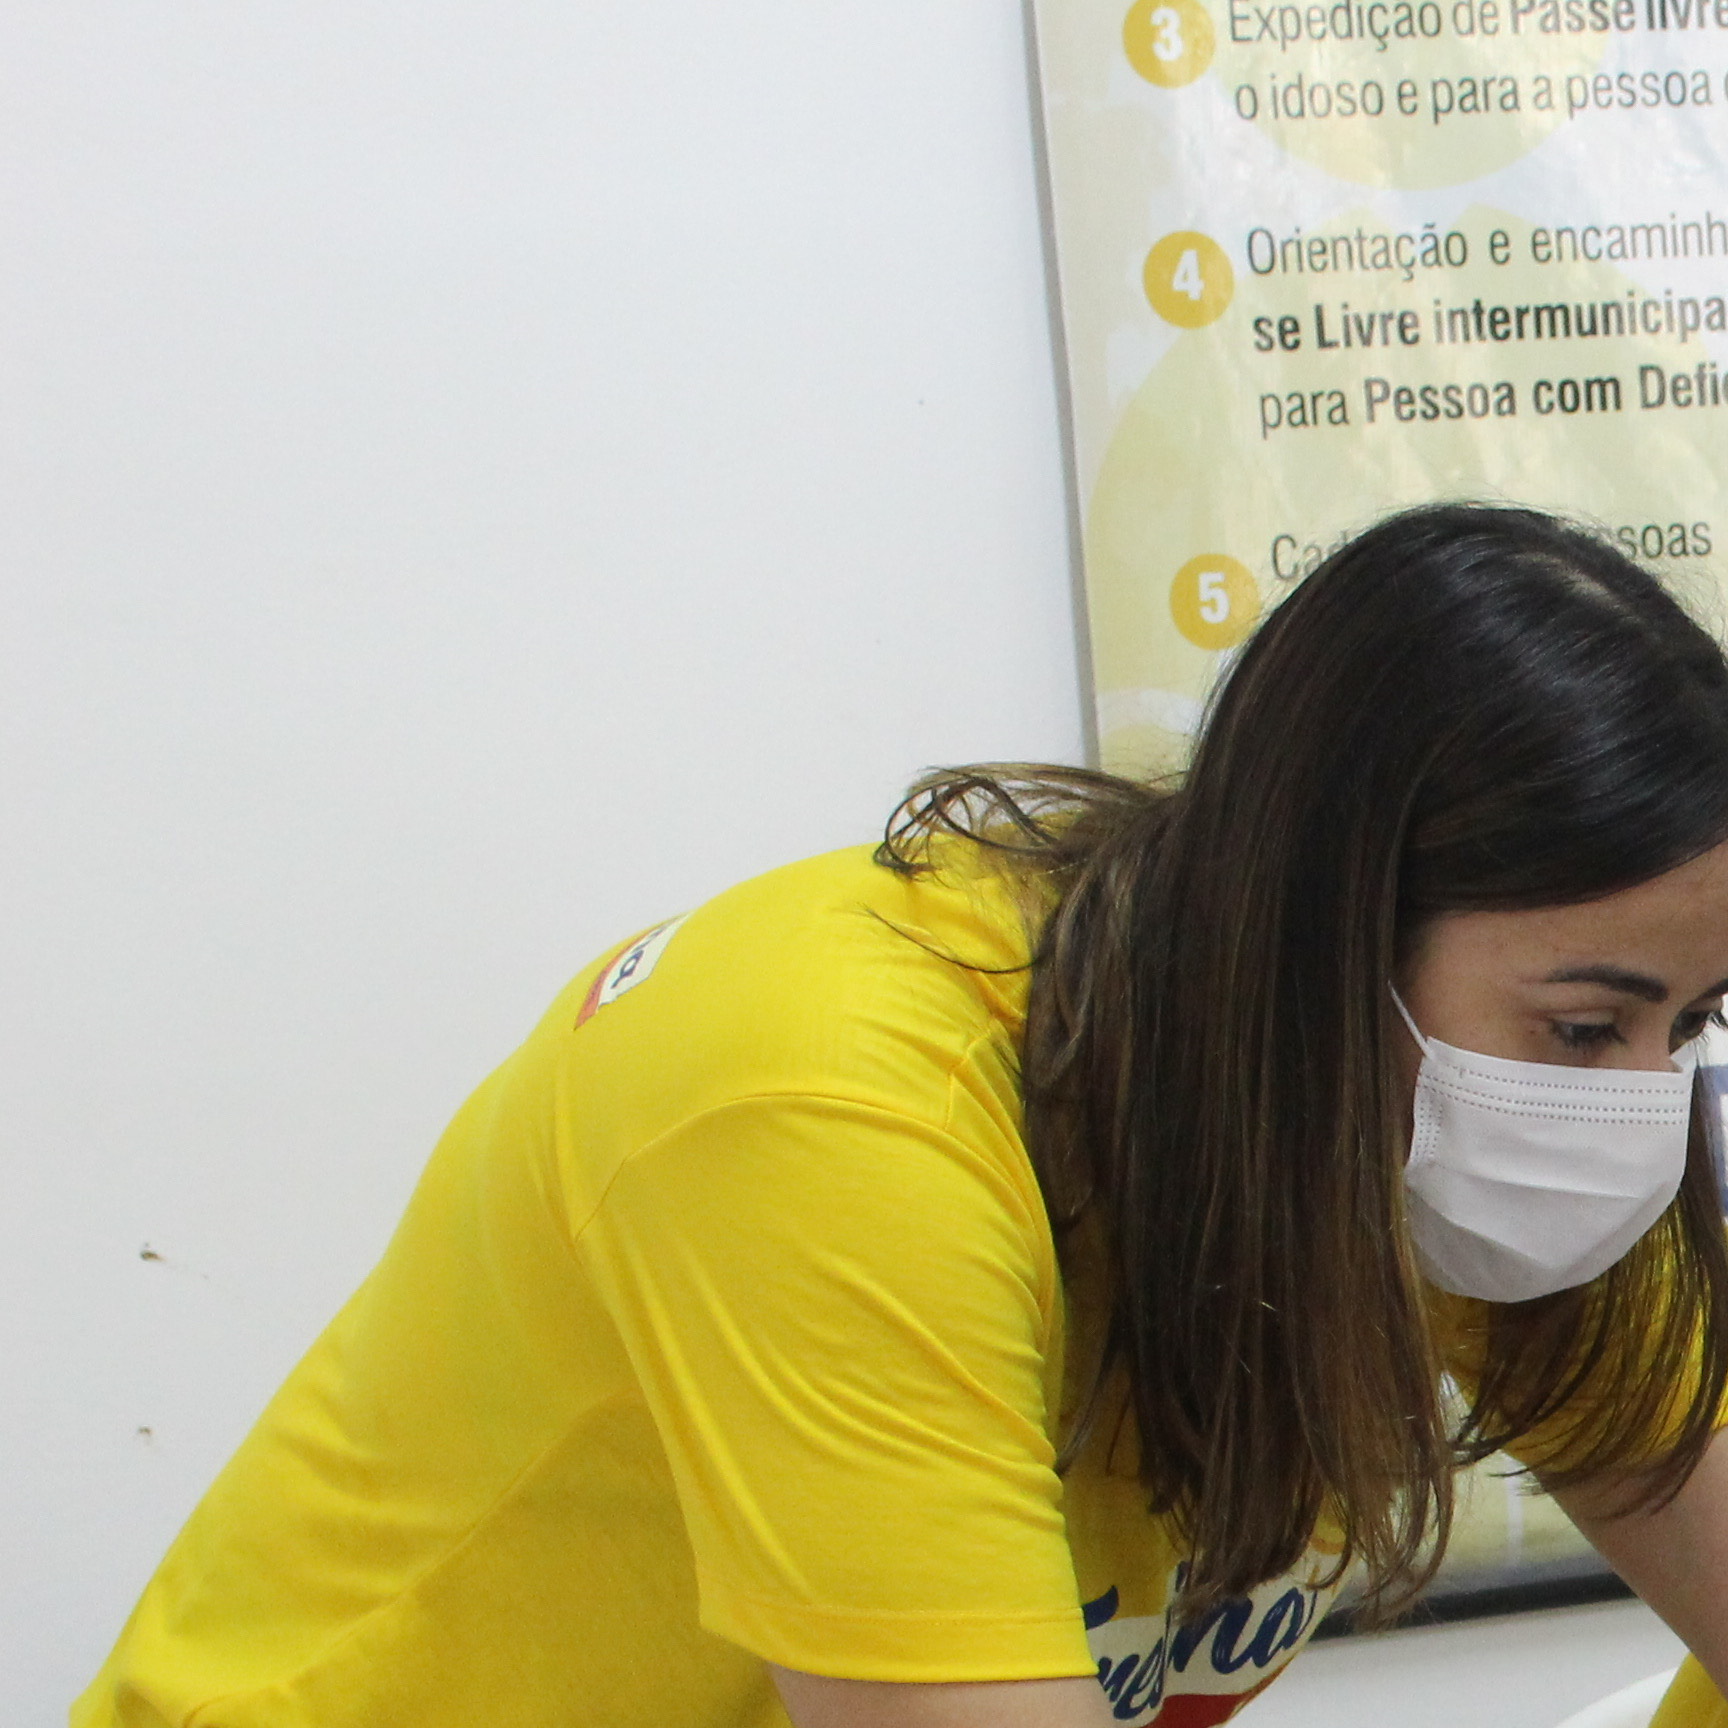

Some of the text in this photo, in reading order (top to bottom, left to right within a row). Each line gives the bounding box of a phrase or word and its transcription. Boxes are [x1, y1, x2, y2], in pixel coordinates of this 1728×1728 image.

[1151, 8, 1184, 60] 3
[1452, 0, 1499, 36] de
[1510, 0, 1636, 35] Passe
[1233, 82, 1260, 122] o
[1270, 74, 1386, 121] idoso
[1395, 78, 1420, 117] e
[1430, 75, 1521, 123] para
[1532, 74, 1555, 112] a
[1565, 69, 1713, 119] pessoa
[1172, 250, 1204, 301] 4
[1246, 222, 1469, 283] Orientação
[1488, 228, 1512, 267] e
[1252, 314, 1302, 353] se
[1313, 302, 1421, 351] Livre
[1259, 389, 1351, 440] para
[1363, 377, 1517, 424] Pessoa
[1532, 375, 1623, 416] com
[1198, 572, 1230, 623] 5
